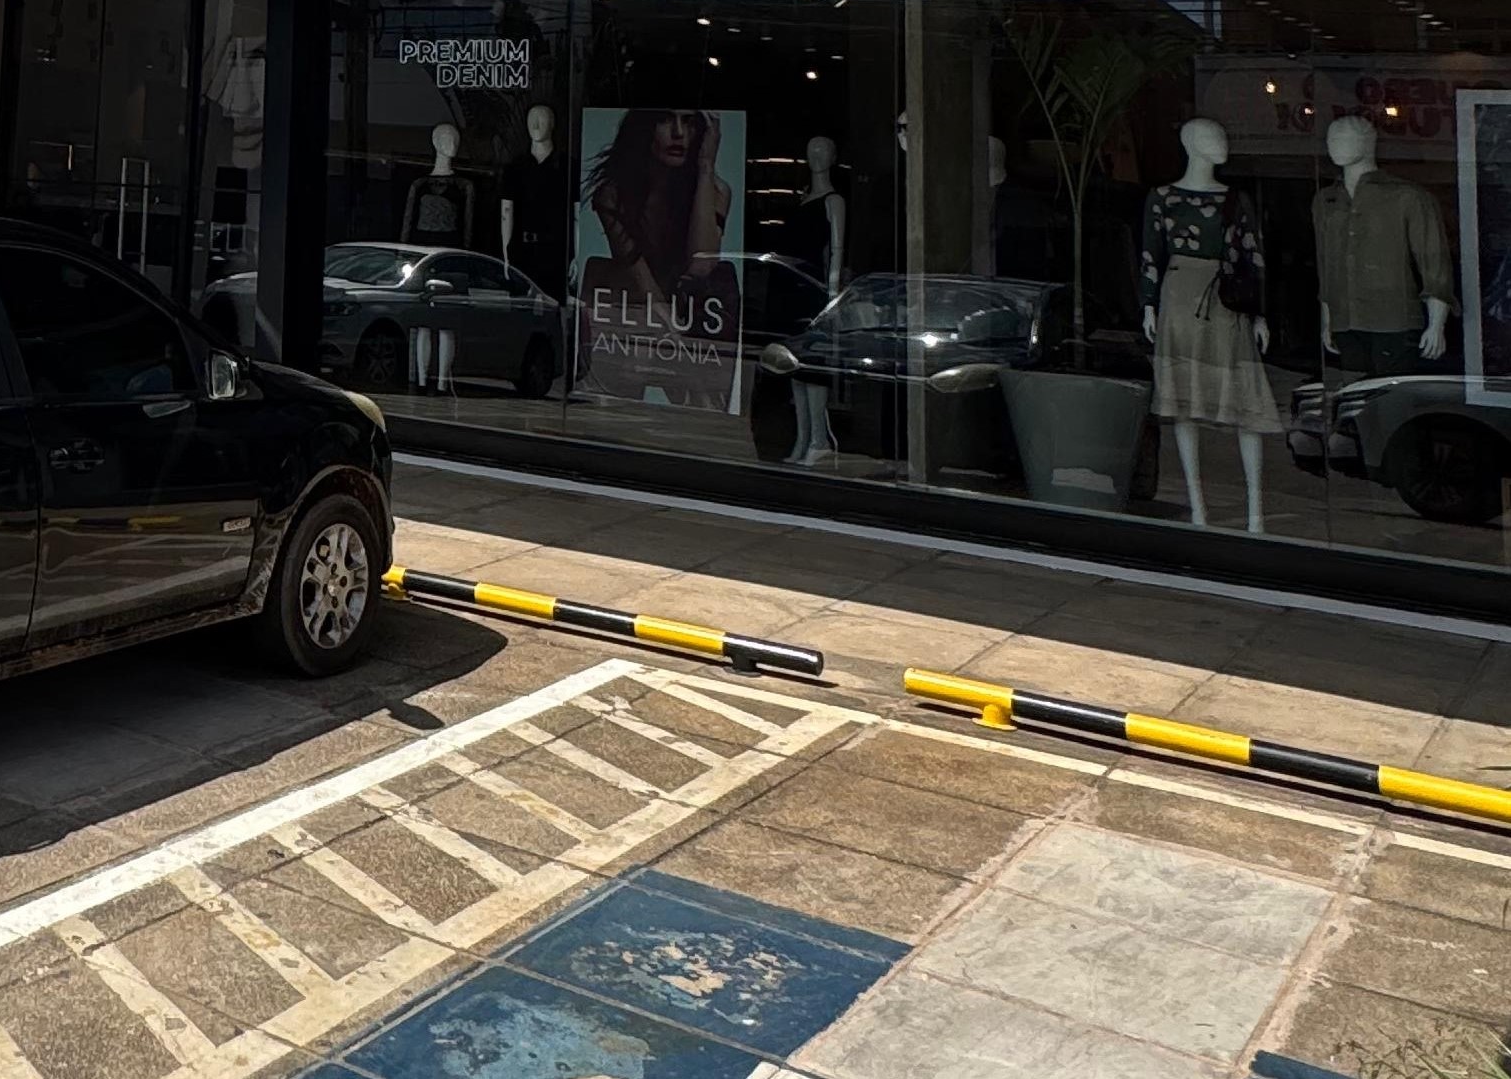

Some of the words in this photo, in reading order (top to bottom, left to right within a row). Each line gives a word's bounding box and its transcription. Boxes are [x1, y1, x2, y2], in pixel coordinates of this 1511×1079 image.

[398, 38, 529, 64] PREMIUM
[436, 63, 529, 88] DENIM
[593, 287, 724, 335] ELLUS
[591, 332, 723, 367] ANTTÓNIA
